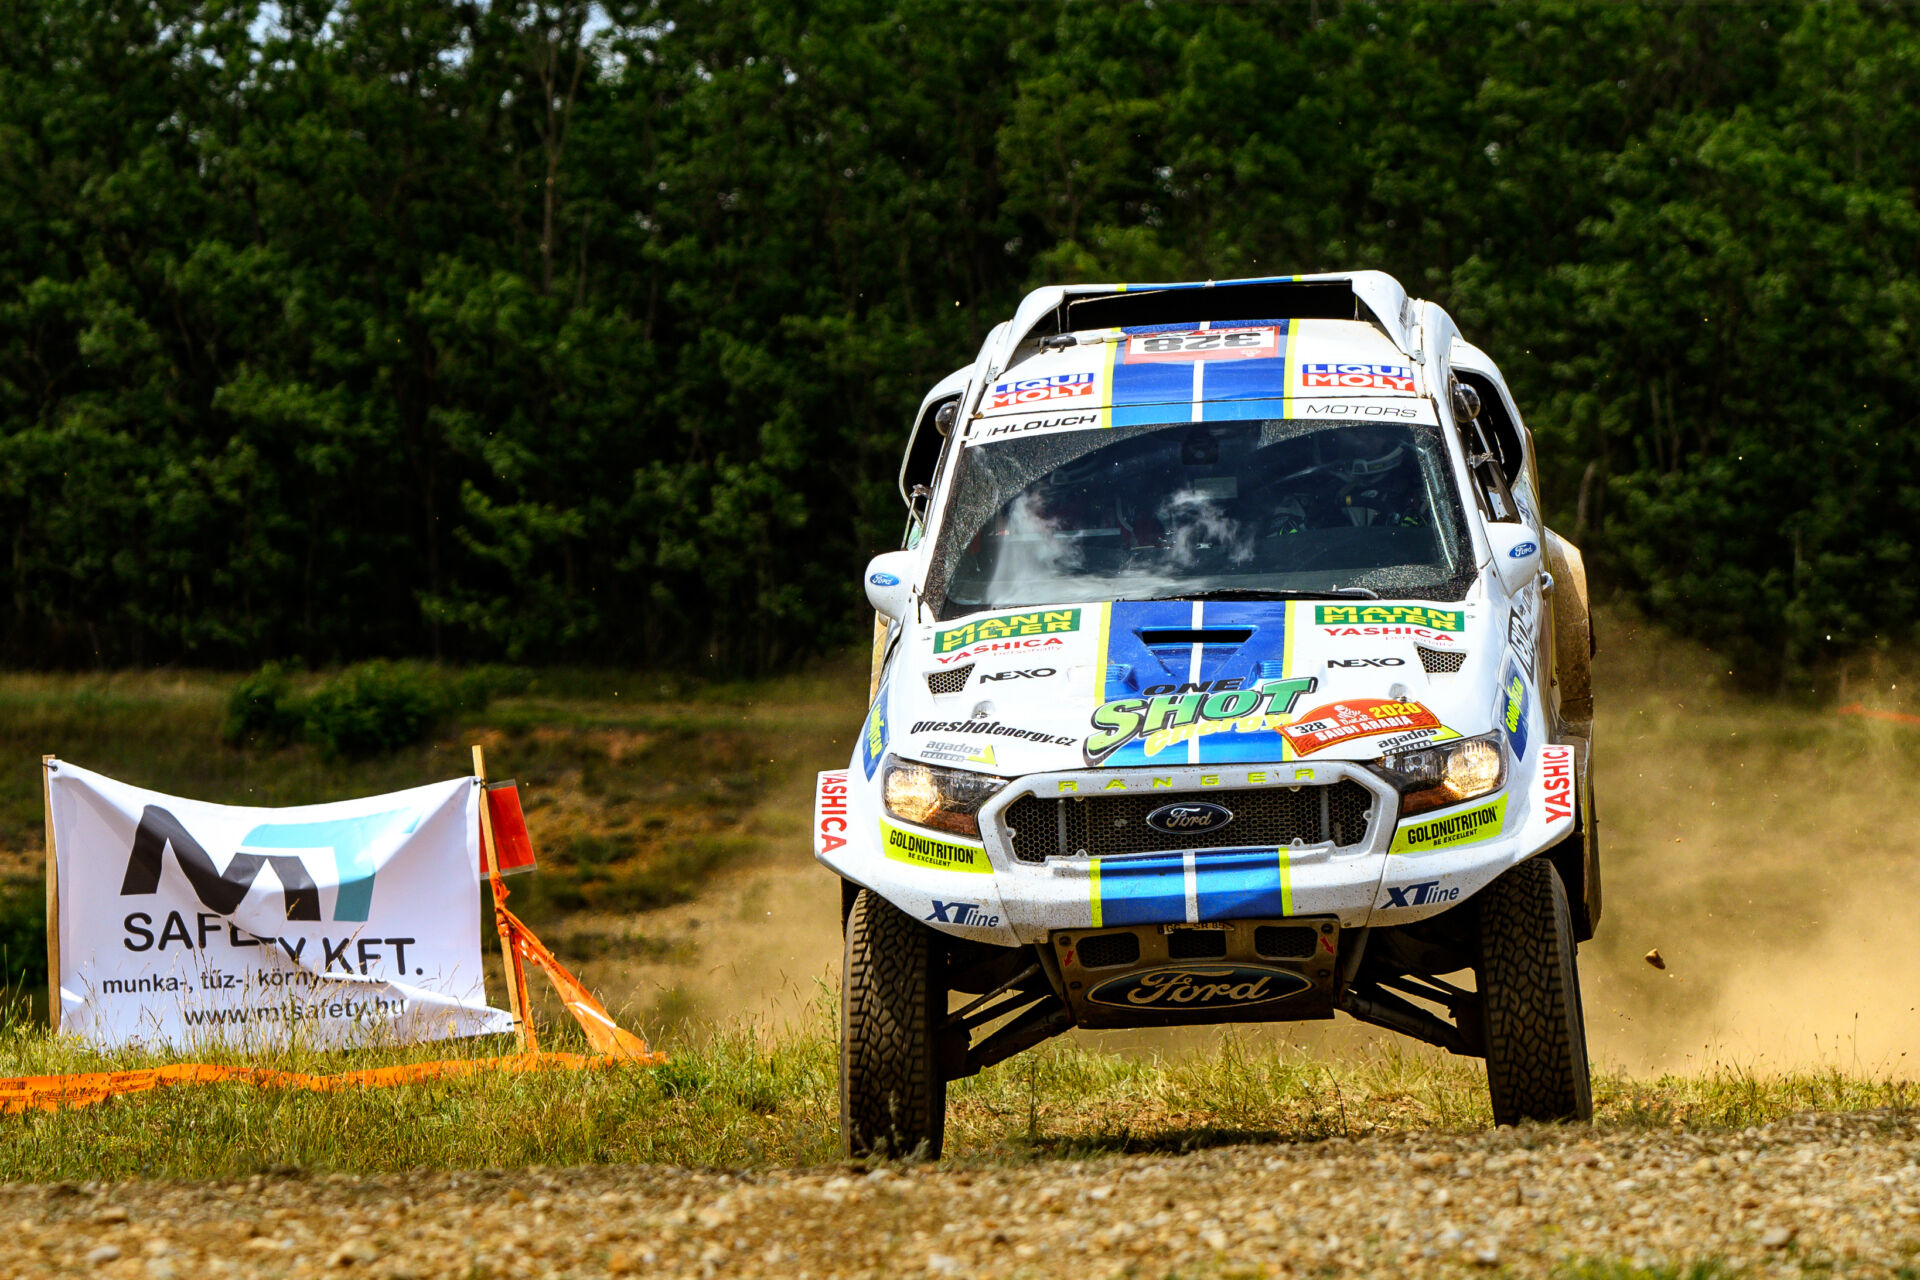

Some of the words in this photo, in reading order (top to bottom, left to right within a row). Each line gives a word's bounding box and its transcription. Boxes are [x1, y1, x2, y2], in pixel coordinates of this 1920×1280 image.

[1144, 333, 1261, 352] 328
[1307, 364, 1412, 379] LIQUI
[1307, 373, 1412, 390] MOLY
[996, 373, 1092, 394] LIQUI
[988, 382, 1092, 408] MOLY
[1306, 404, 1418, 418] MOTORS
[1515, 544, 1534, 558] Ford
[1323, 606, 1457, 622] MANN
[1323, 614, 1457, 631] FILTER
[942, 621, 1072, 652] FILTER
[943, 610, 1073, 642] MANN
[1323, 627, 1455, 642] YASHICA
[936, 637, 1064, 664] YASHICA
[1327, 657, 1406, 669] NEXO
[979, 667, 1057, 684] NEXO
[1143, 676, 1246, 696] ONE
[1368, 702, 1422, 719] 2020
[910, 718, 1078, 746] oneshotenergy.cz
[1083, 676, 1319, 767] SHOT
[1294, 721, 1327, 734] 328
[1313, 725, 1360, 742] SAUDI
[1361, 715, 1414, 731] ARABIA
[1144, 713, 1292, 757] energy
[1377, 728, 1438, 748] agados
[926, 740, 983, 756] agados
[1057, 768, 1316, 792] RANGER
[1542, 746, 1572, 825] YASHICA
[820, 771, 848, 855] YASHICA
[1166, 807, 1213, 828] Ford
[1407, 805, 1498, 844] GOLDNUTRITION
[889, 829, 975, 864] GOLDNUTRITION
[1433, 838, 1442, 846] BE
[1443, 828, 1478, 843] EXCELLENT
[917, 853, 951, 867] EXCELLENT
[1380, 880, 1460, 909] XTline
[925, 900, 999, 928] XTline
[123, 911, 307, 965] SAFEY
[322, 937, 424, 976] KFT.
[1127, 970, 1273, 1004] Ford
